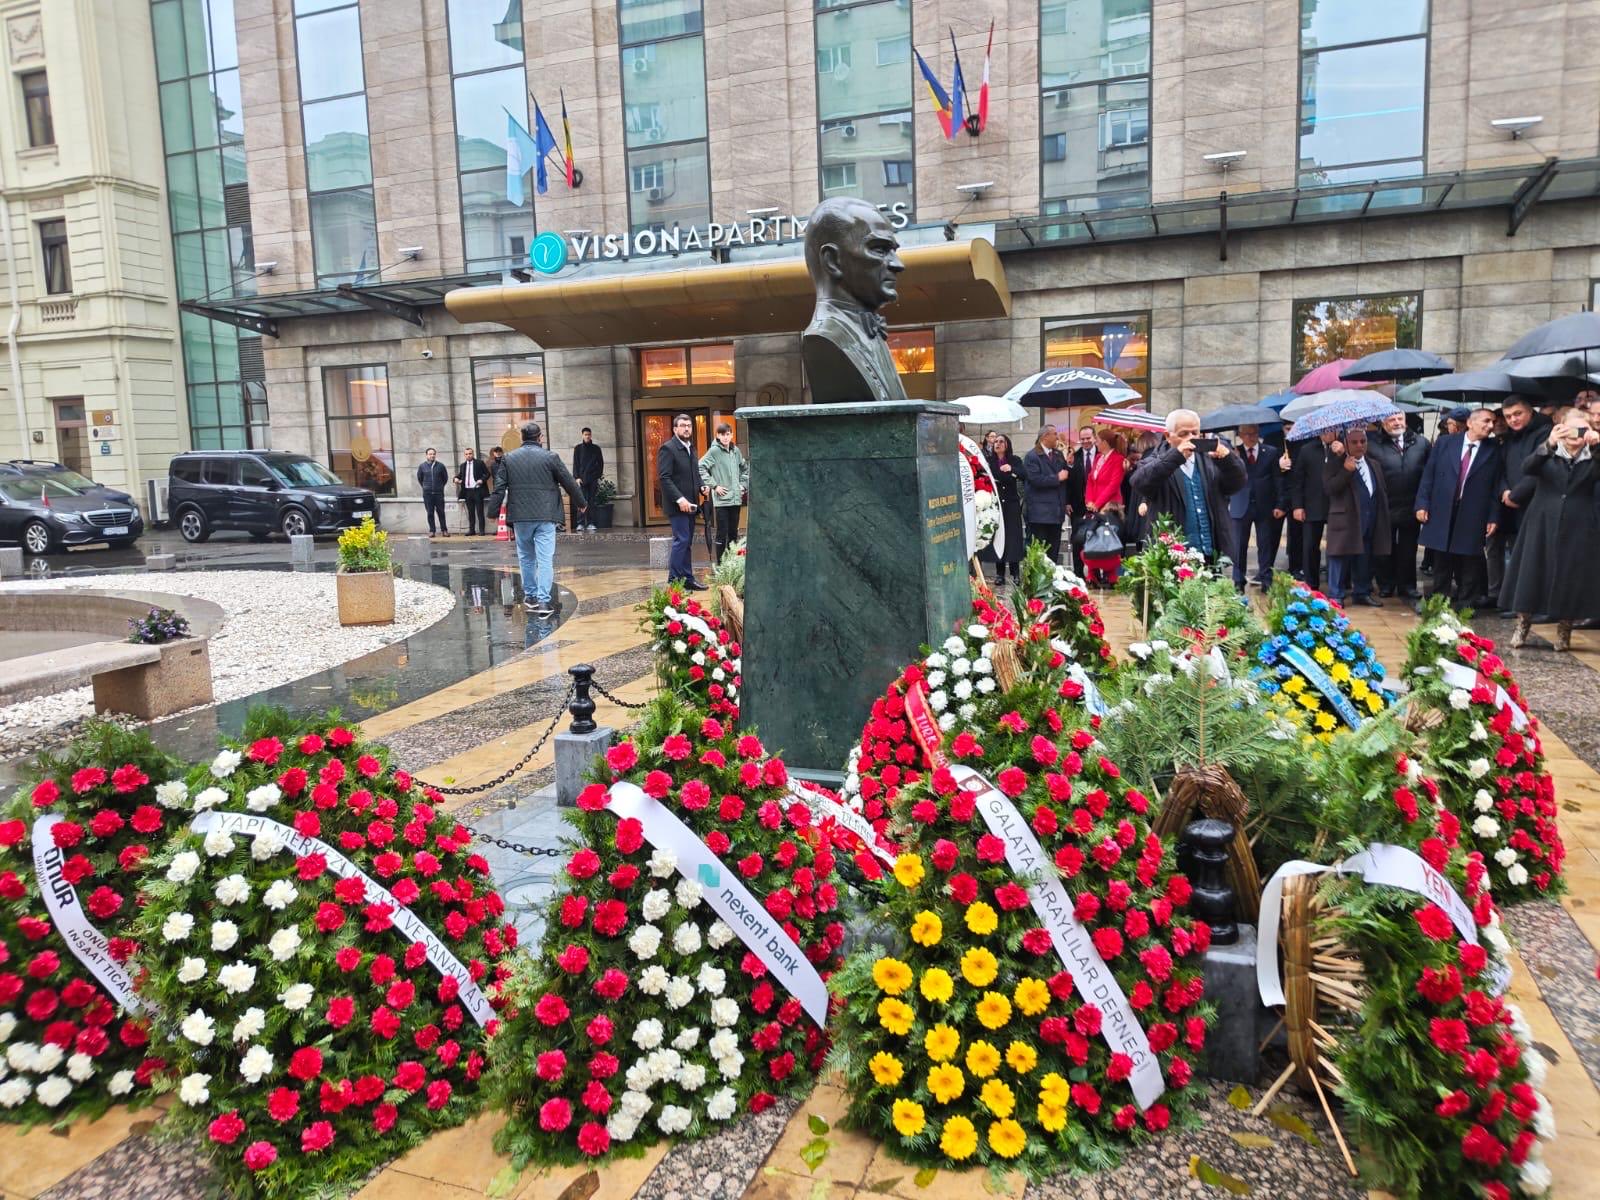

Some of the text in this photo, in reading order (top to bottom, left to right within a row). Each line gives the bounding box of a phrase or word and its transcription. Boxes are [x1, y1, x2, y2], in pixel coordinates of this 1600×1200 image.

[571, 201, 909, 261] VISIONAPARTMS
[44, 847, 75, 909] ONUR
[219, 814, 266, 833] YAPI
[405, 914, 425, 942] VE
[989, 799, 1099, 986] GALATASARAYLILAR
[67, 928, 106, 967] INSAAT
[720, 887, 801, 977] nexent bank
